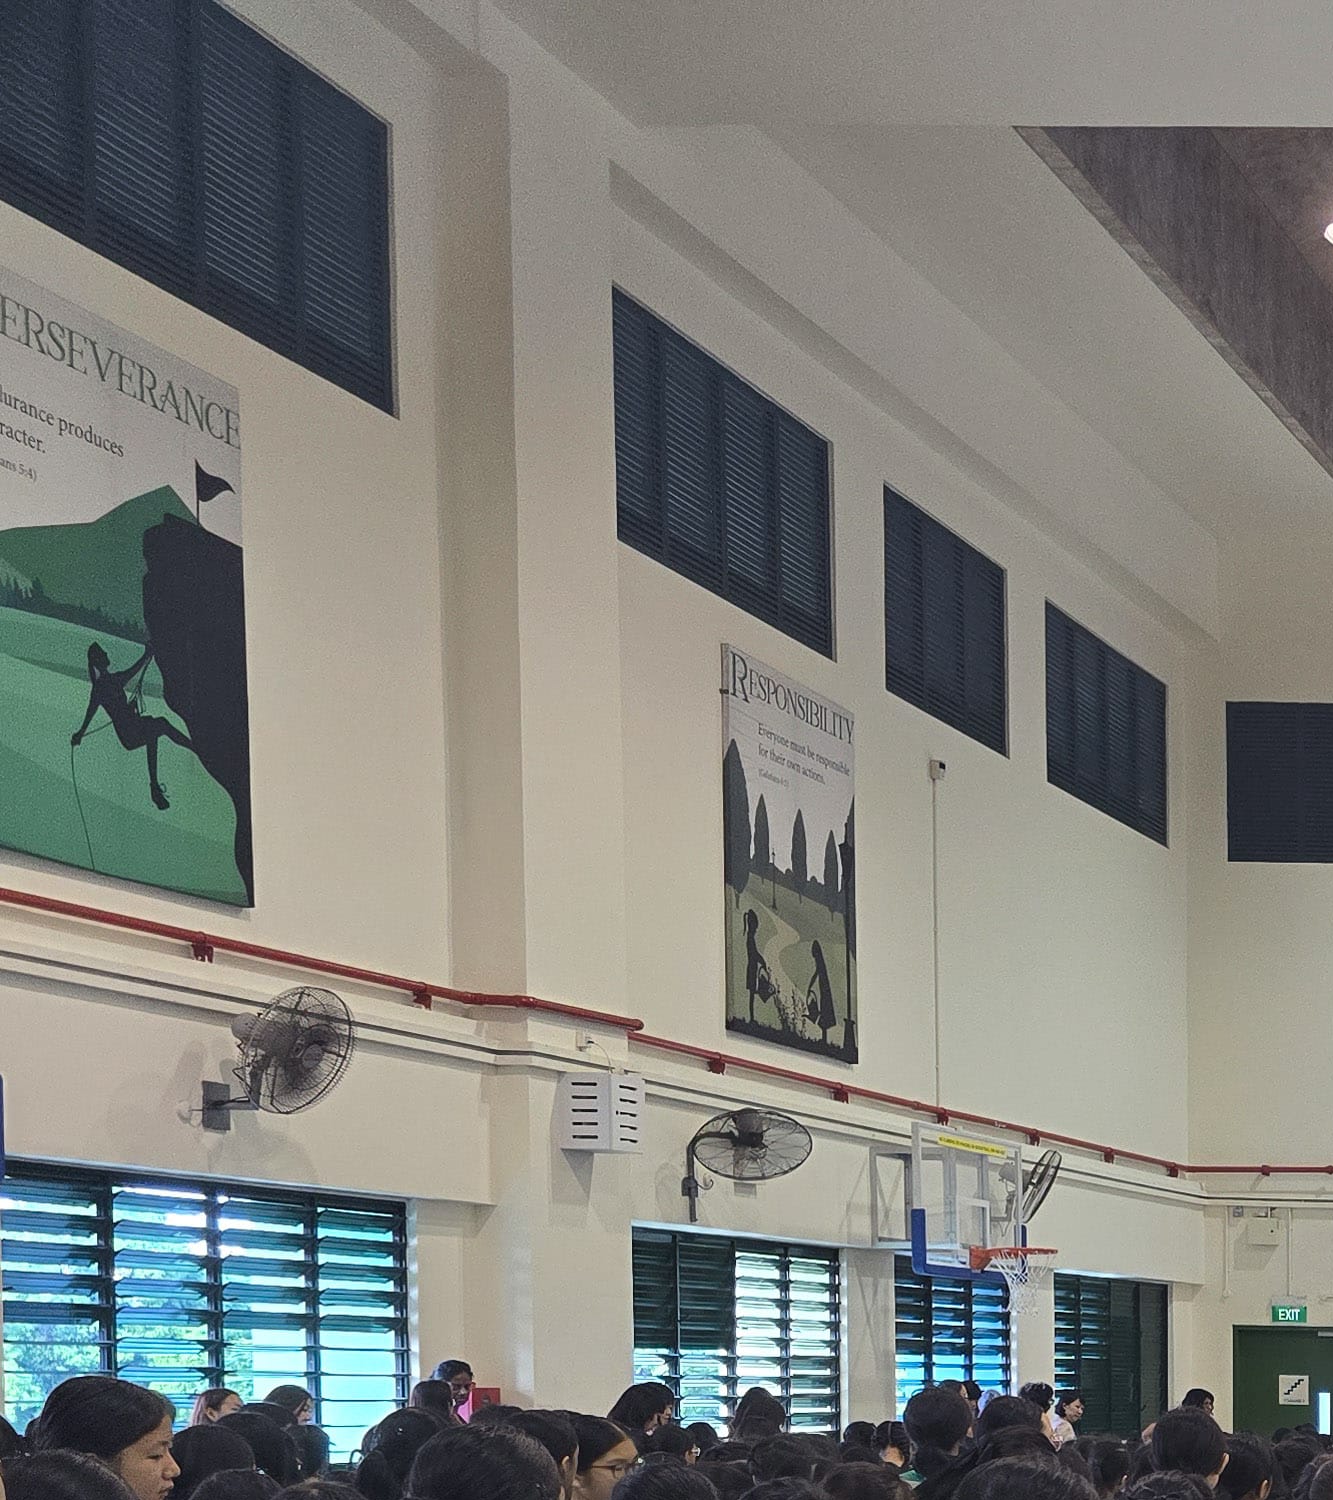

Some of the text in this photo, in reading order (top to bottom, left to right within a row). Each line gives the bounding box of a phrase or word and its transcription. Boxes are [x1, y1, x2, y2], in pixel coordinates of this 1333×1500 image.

[57, 417, 124, 458] produces
[730, 651, 855, 744] RESPONSIBILITY
[758, 722, 789, 748] Everyone
[1278, 1308, 1300, 1321] EXIT
